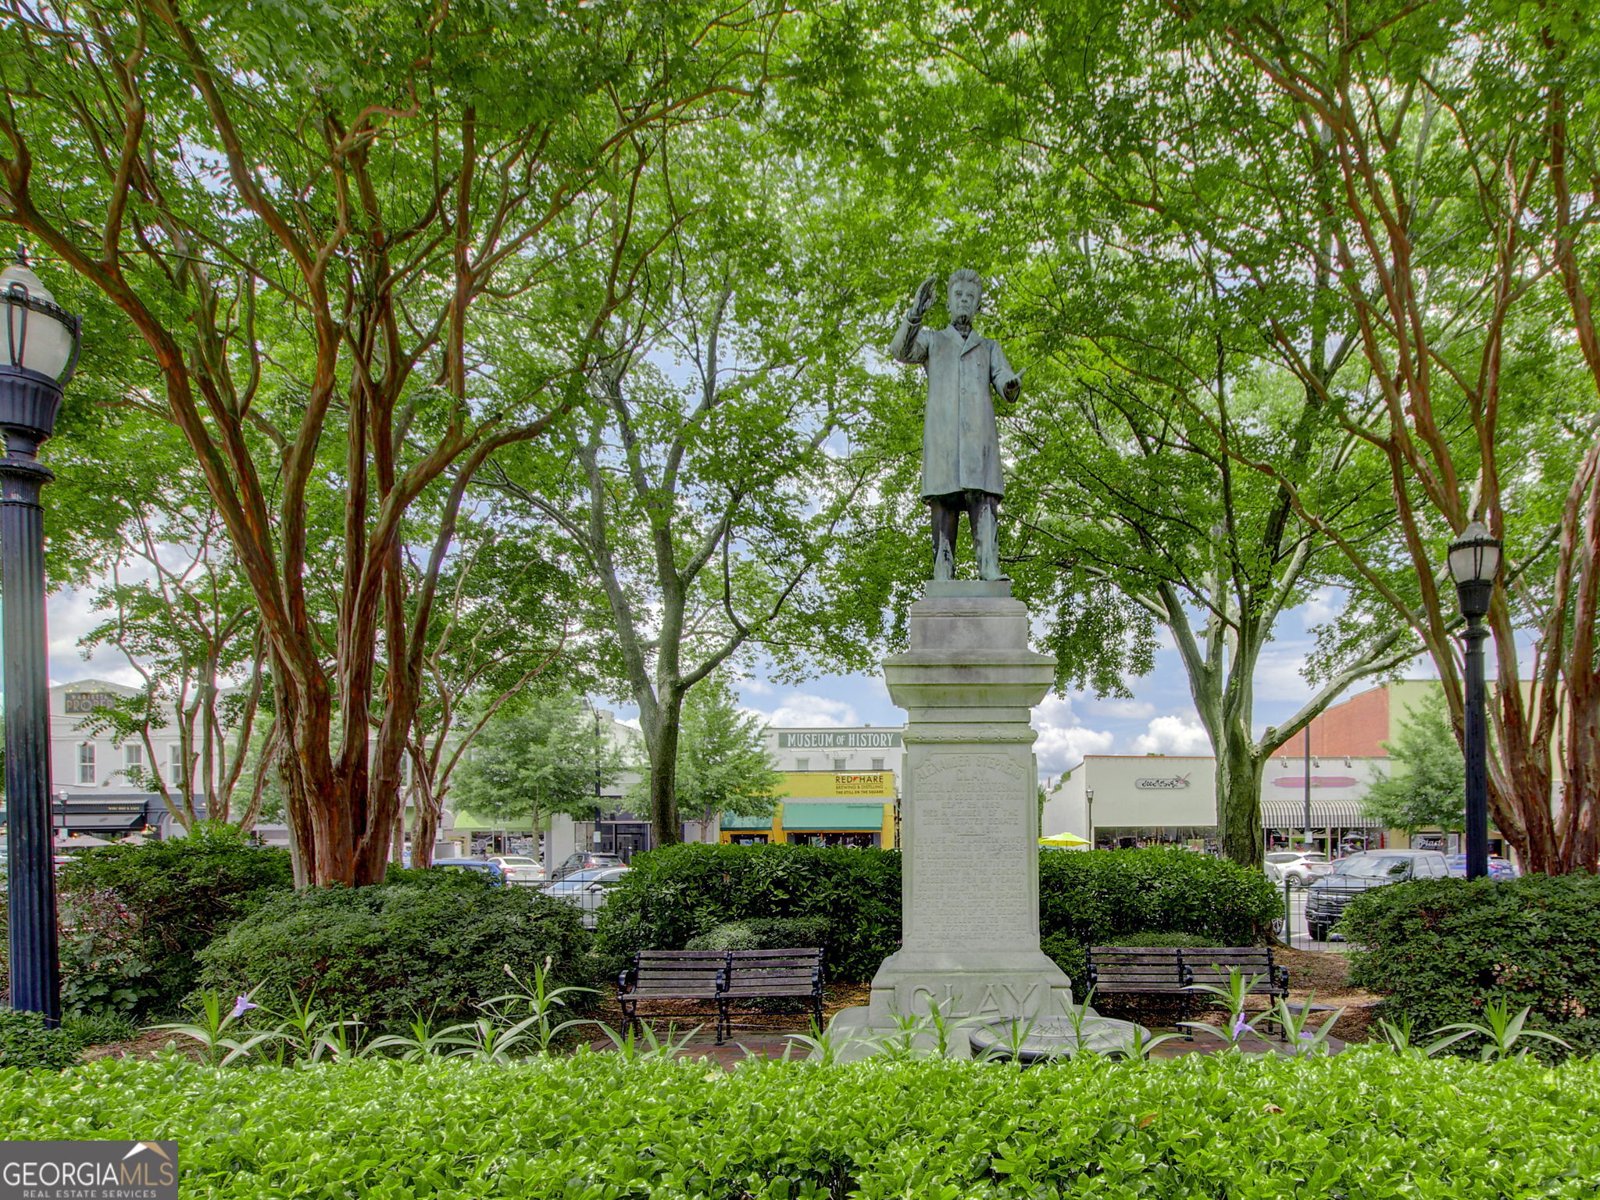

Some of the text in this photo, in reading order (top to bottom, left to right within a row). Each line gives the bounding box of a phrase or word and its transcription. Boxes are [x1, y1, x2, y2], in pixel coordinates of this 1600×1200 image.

[787, 733, 894, 748] MUSEUM OF HISTORY
[835, 775, 884, 784] RED HARE
[910, 983, 1039, 1019] CLAY
